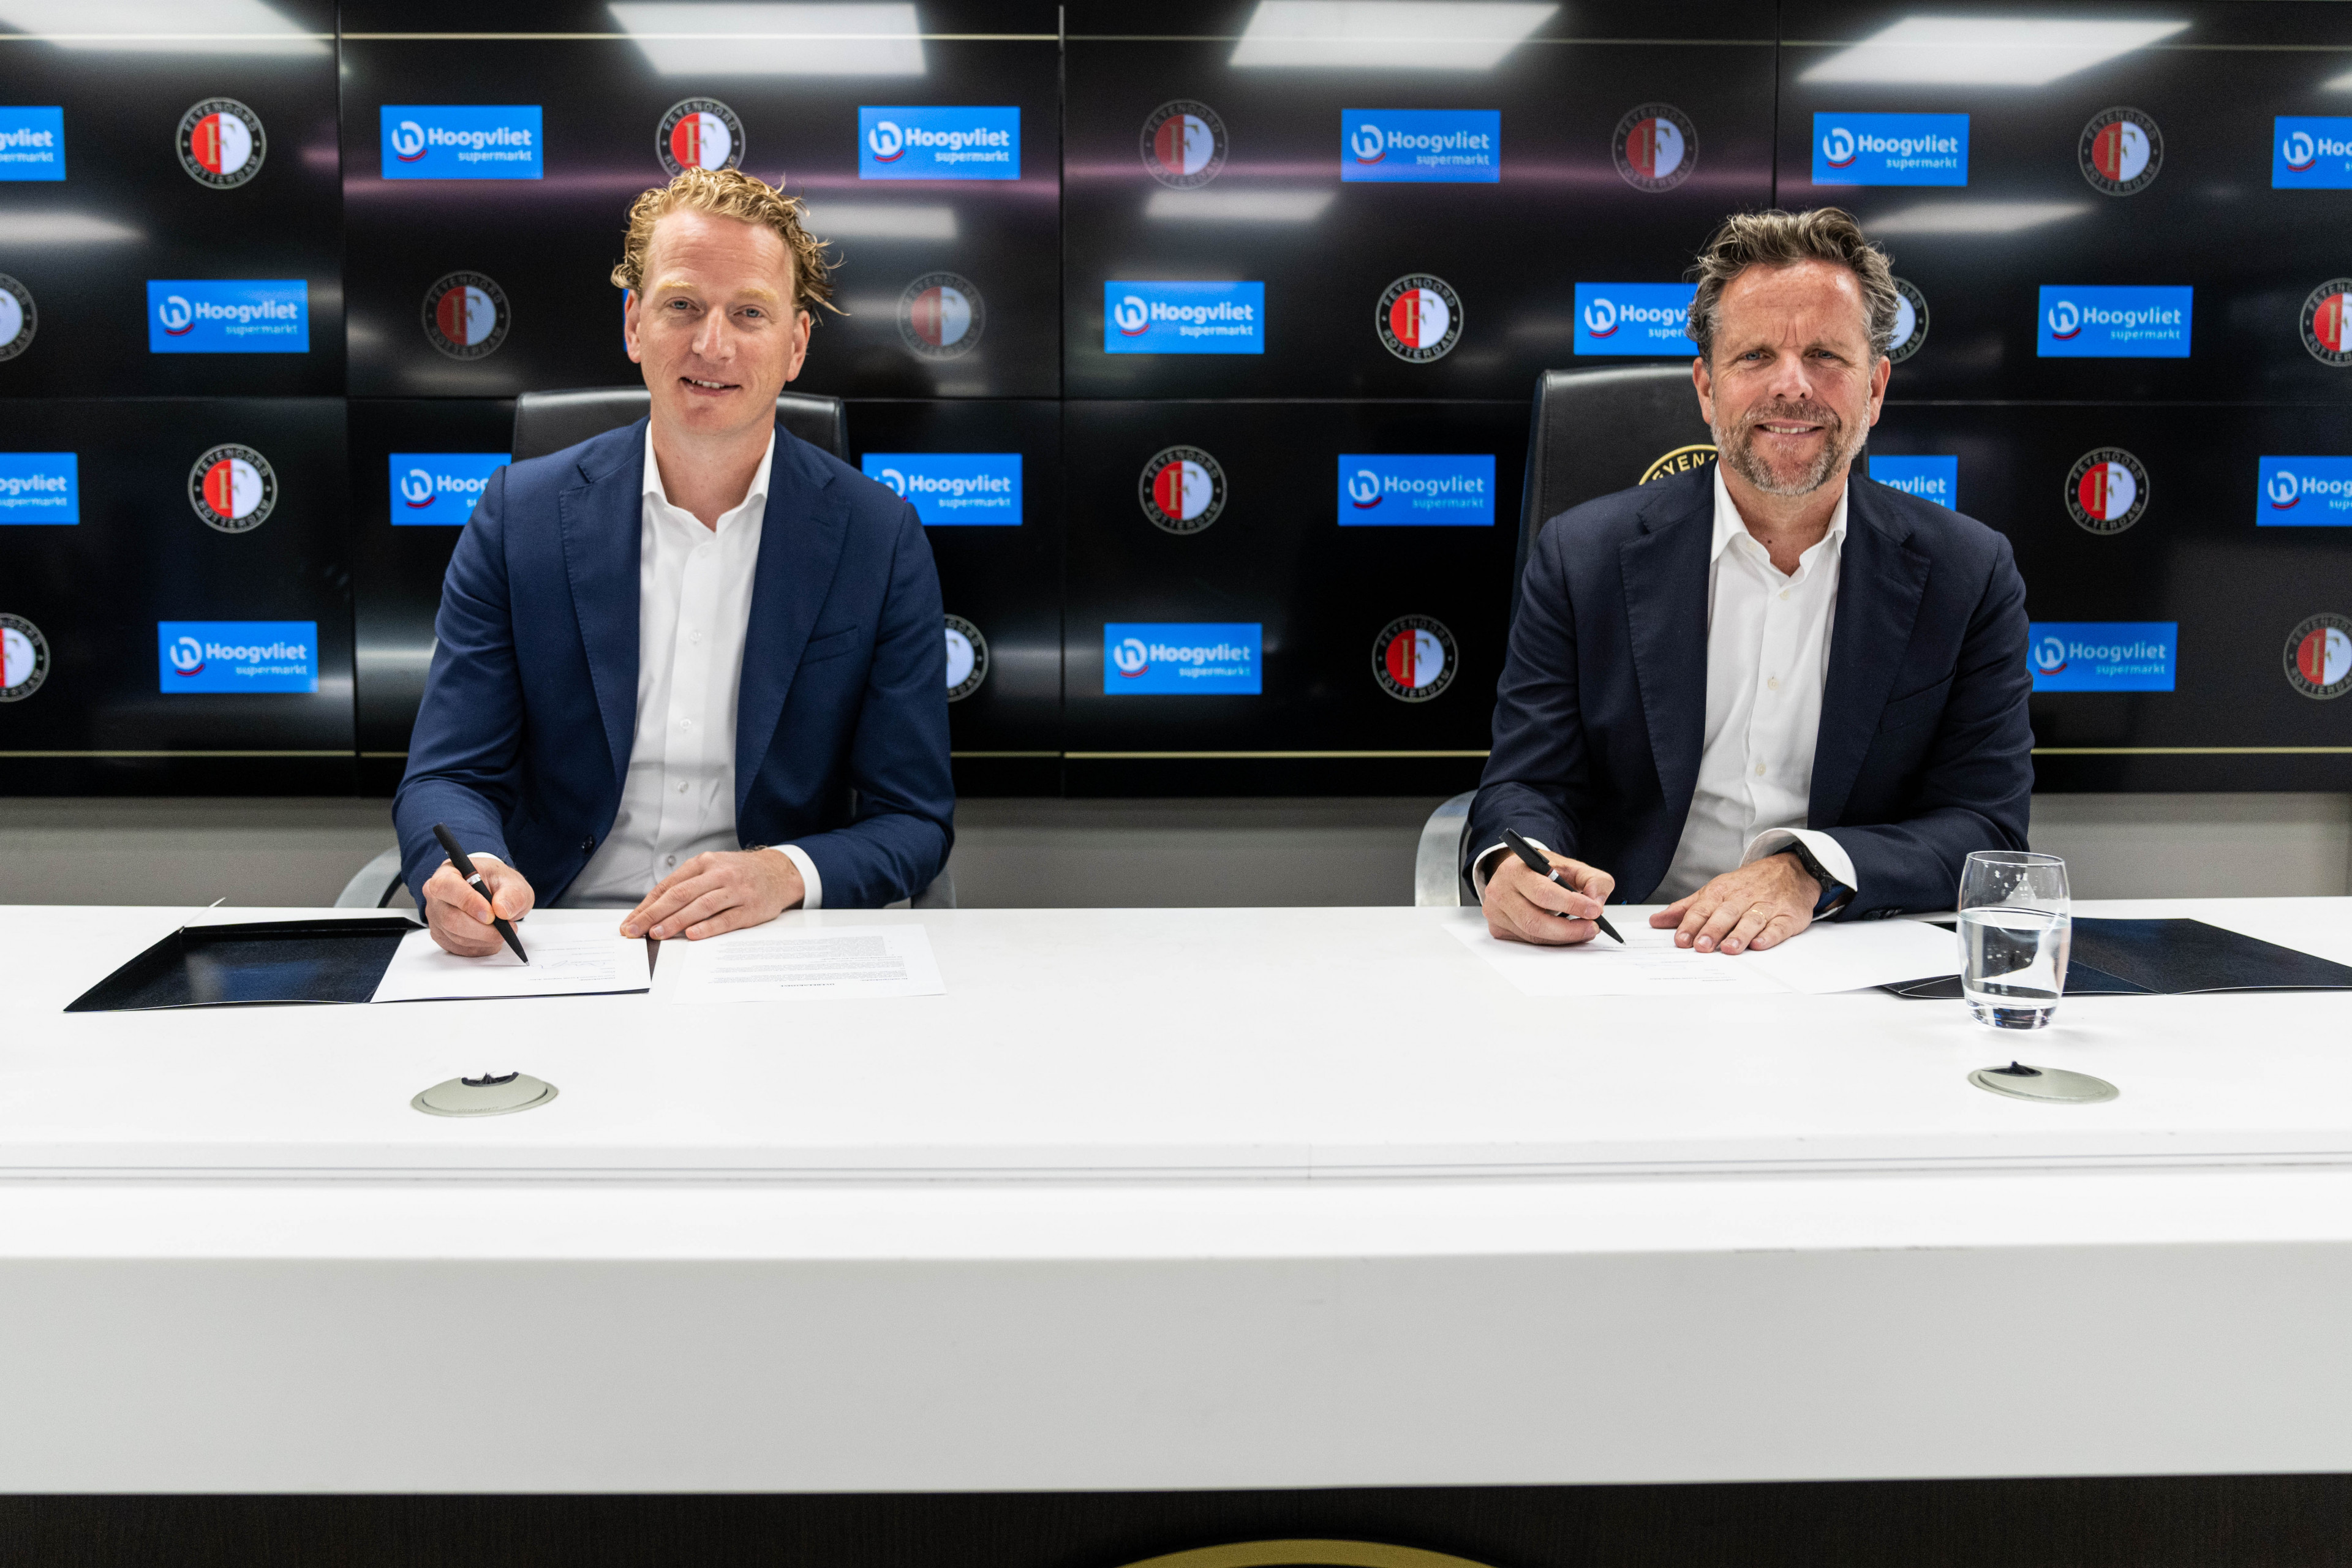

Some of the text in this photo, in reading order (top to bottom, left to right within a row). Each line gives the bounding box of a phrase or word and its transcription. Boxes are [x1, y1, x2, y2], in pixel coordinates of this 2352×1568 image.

[428, 127, 532, 150] Hoogvliet
[905, 127, 1010, 151] Hoogvliet
[1387, 130, 1490, 154] Hoogvliet
[1858, 134, 1958, 157] Hoogvliet
[458, 150, 532, 164] supermarkt
[935, 151, 1009, 165] supermarkt
[1416, 154, 1490, 167] supermarkt
[1886, 157, 1958, 171] supermarkt
[1382, 278, 1455, 307] FEYENOORD
[195, 301, 298, 323] Hoogvliet
[1150, 301, 1254, 325] Hoogvliet
[2082, 307, 2182, 328] Hoogvliet
[225, 325, 298, 338] supermarkt
[1178, 325, 1254, 339] supermarkt
[2110, 329, 2180, 342] supermarkt
[1382, 329, 1457, 359] ROTTERDAM
[909, 475, 1012, 496] Hoogvliet
[1384, 476, 1484, 497] Hoogvliet
[938, 496, 1011, 509] supermarkt
[1412, 498, 1483, 512] supermarkt
[206, 642, 307, 663] Hoogvliet
[1149, 644, 1251, 665] Hoogvliet
[2069, 641, 2166, 663] Hoogvliet
[235, 664, 308, 677] supermarkt
[1177, 666, 1251, 680] supermarkt
[2096, 663, 2166, 677] supermarkt
